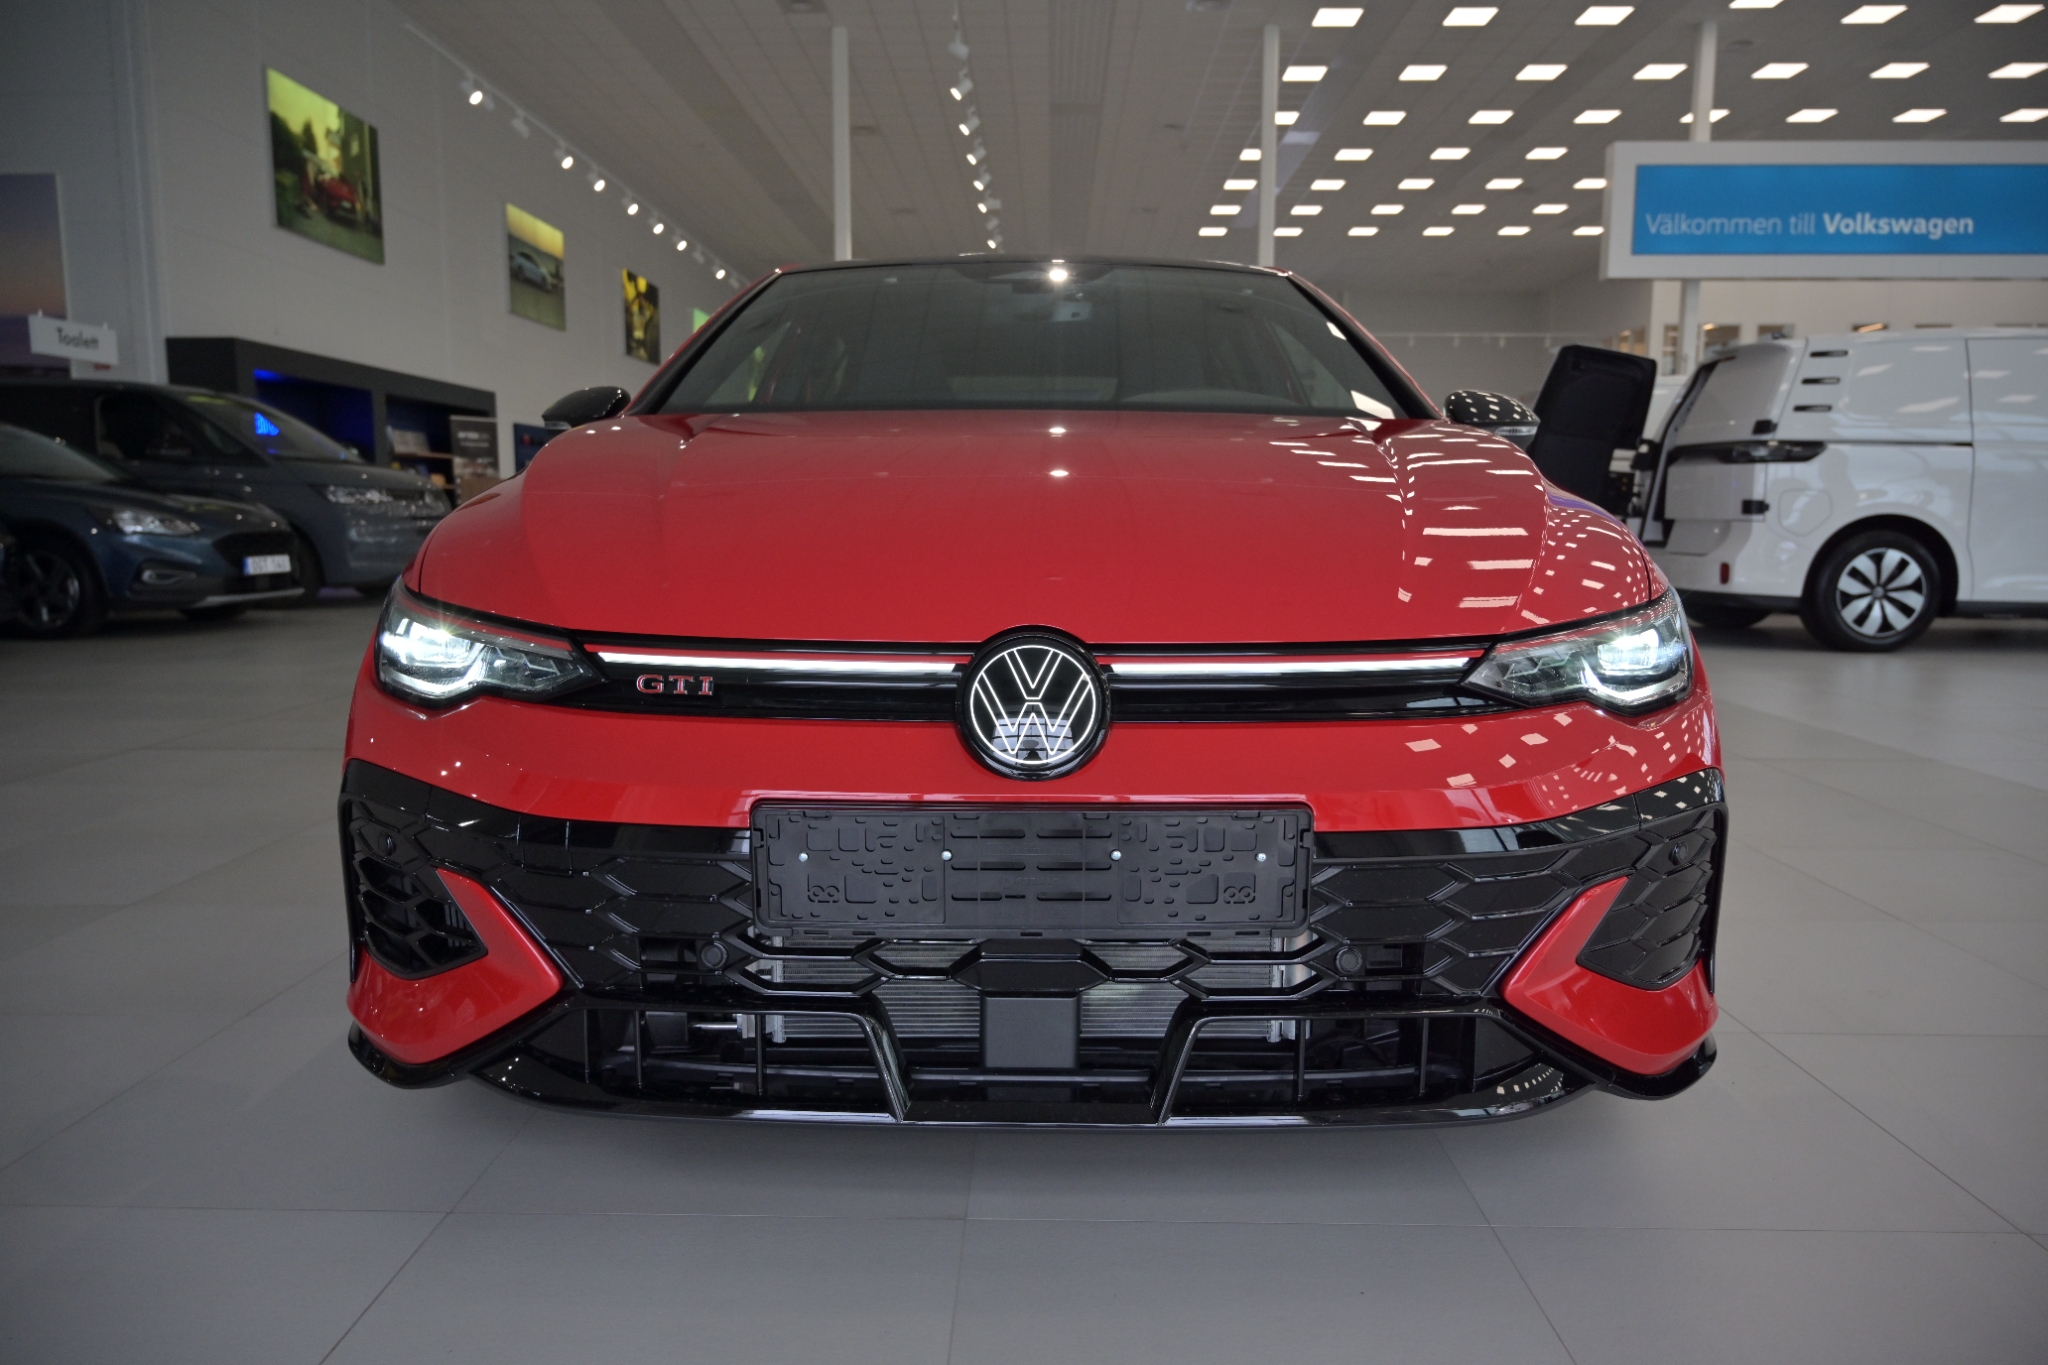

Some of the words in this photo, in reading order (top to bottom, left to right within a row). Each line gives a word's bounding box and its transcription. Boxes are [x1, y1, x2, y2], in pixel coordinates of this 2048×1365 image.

[1645, 212, 1782, 235] Välkommen
[1789, 213, 1816, 235] till
[1822, 212, 1974, 240] Volkswagen
[56, 326, 99, 350] Toalett
[636, 673, 714, 696] GTI
[970, 645, 1097, 765] VW
